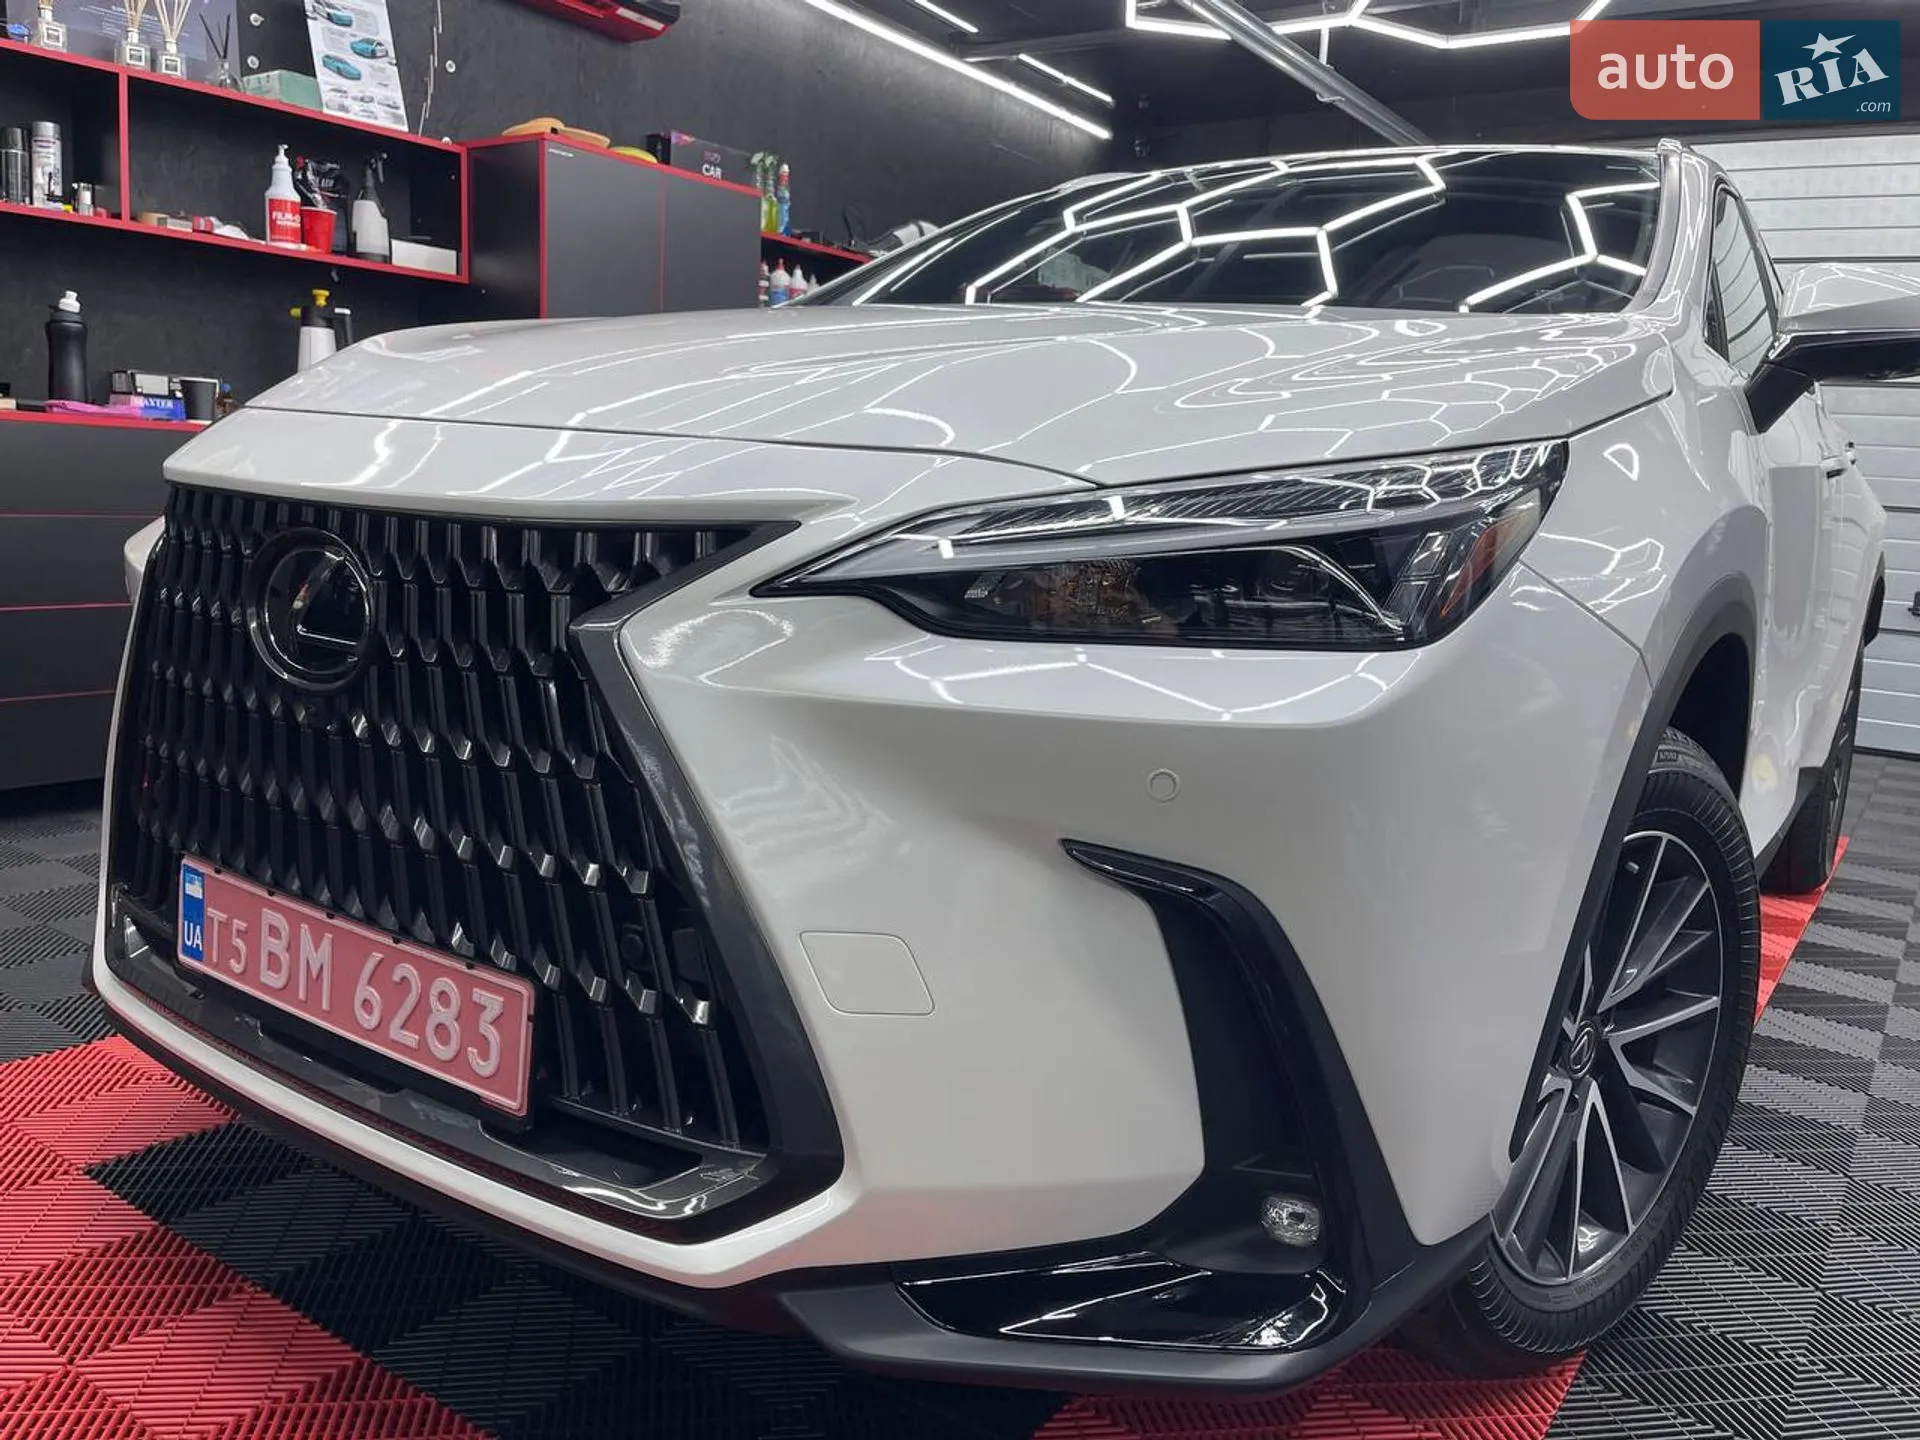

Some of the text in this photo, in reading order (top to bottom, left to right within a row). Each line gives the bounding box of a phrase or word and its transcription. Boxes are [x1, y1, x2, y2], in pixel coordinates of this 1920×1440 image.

[702, 163, 722, 180] CAR
[184, 920, 203, 952] UA
[207, 907, 505, 1079] T5 BM 6283
